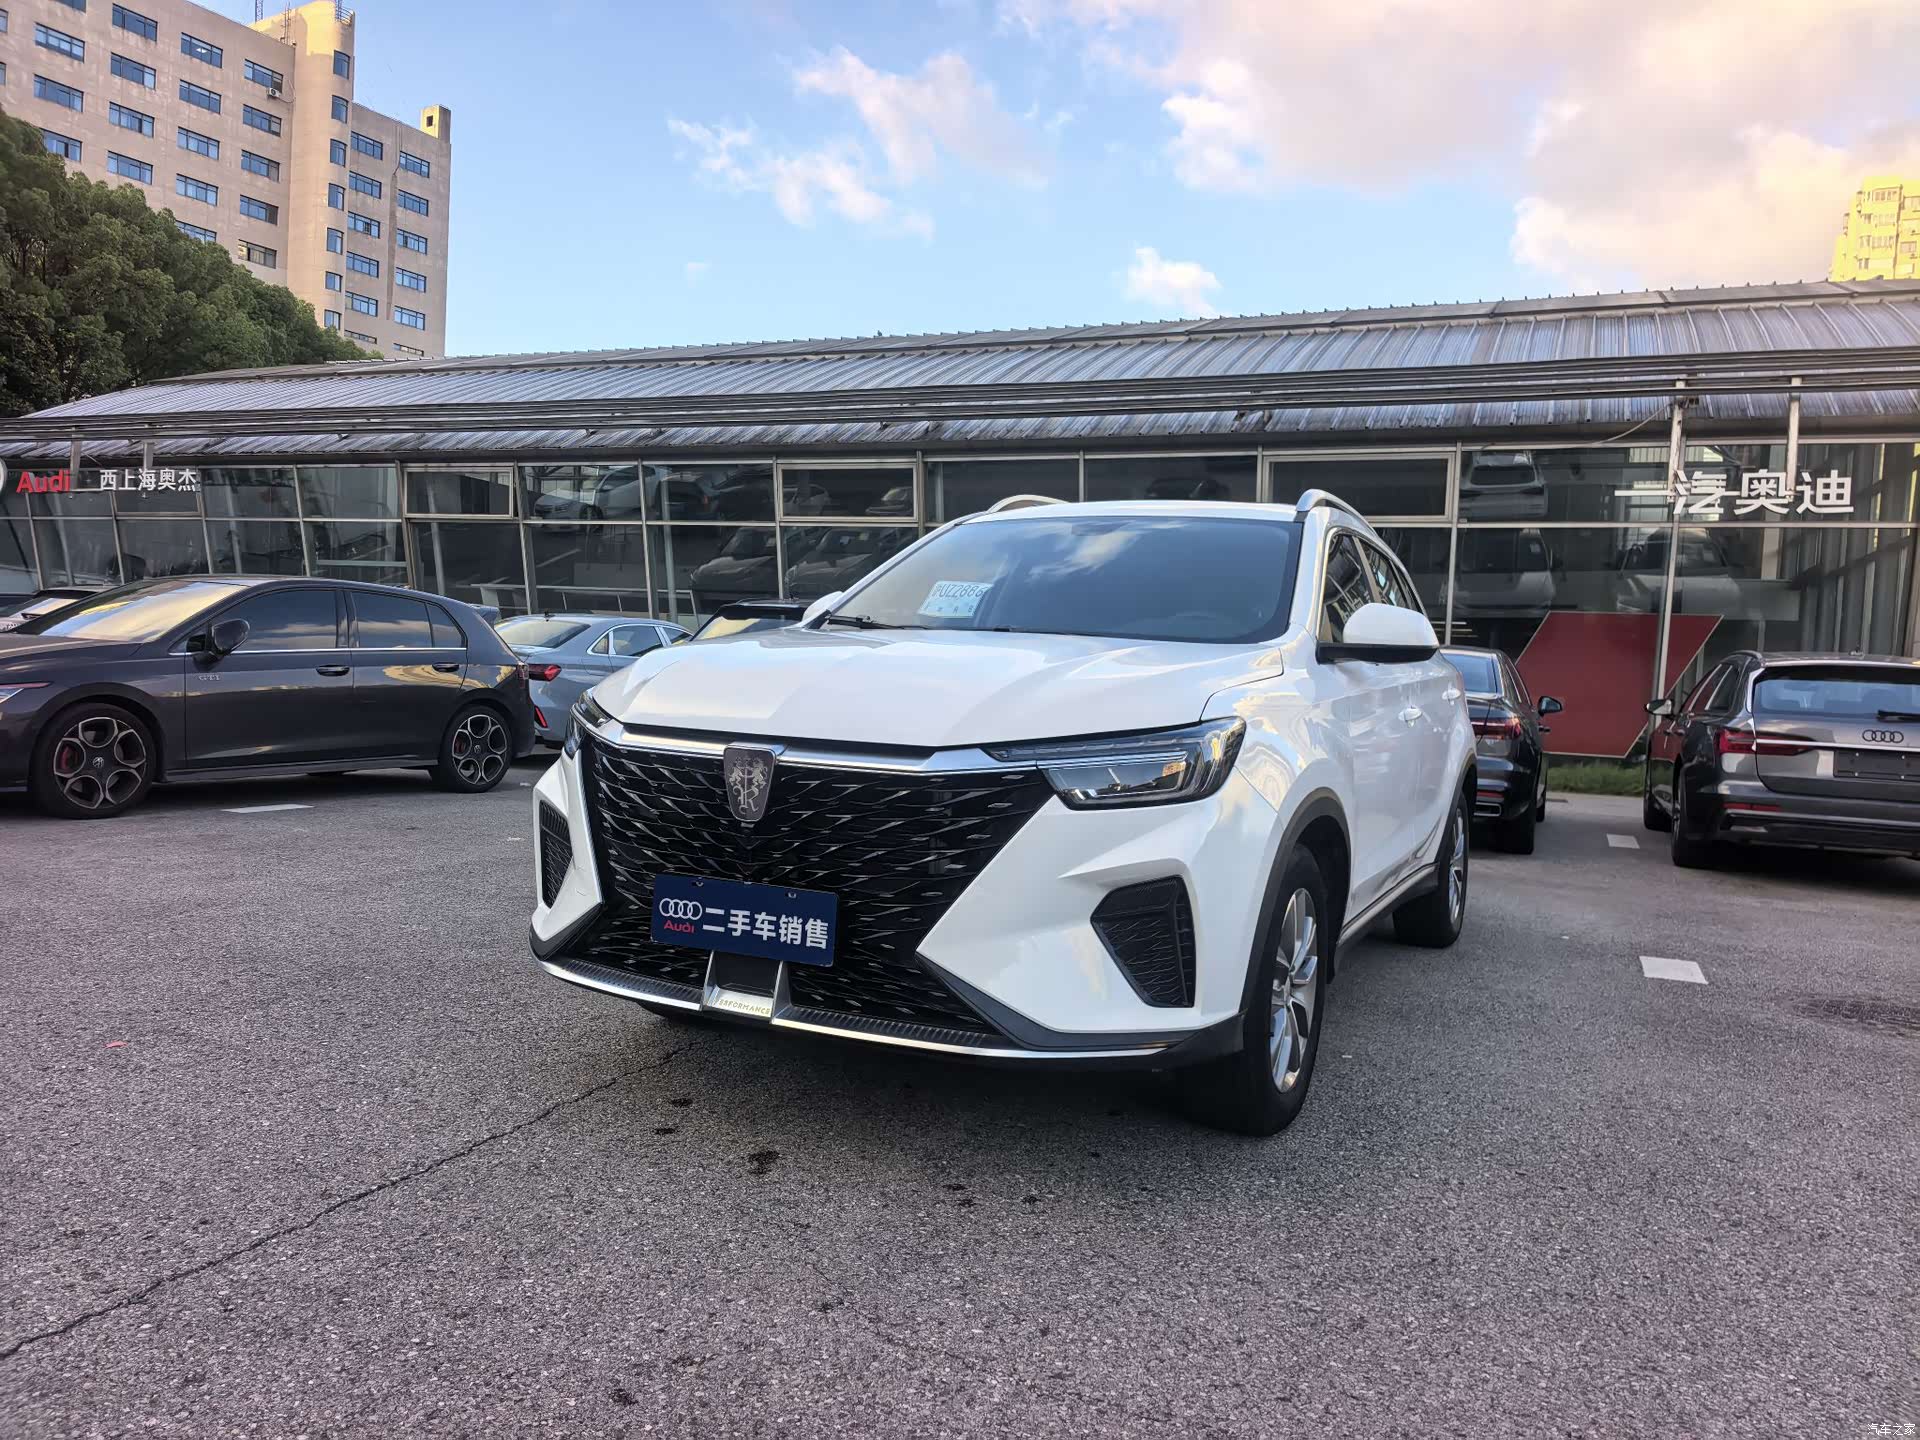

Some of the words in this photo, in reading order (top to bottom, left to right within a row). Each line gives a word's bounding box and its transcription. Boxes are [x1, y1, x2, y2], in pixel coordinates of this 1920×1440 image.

[16, 469, 70, 493] Audi
[100, 468, 197, 492] 西上海奥杰
[1614, 469, 1854, 515] 一汽奥迪
[663, 919, 695, 934] Audi
[702, 906, 829, 950] 二手车销售
